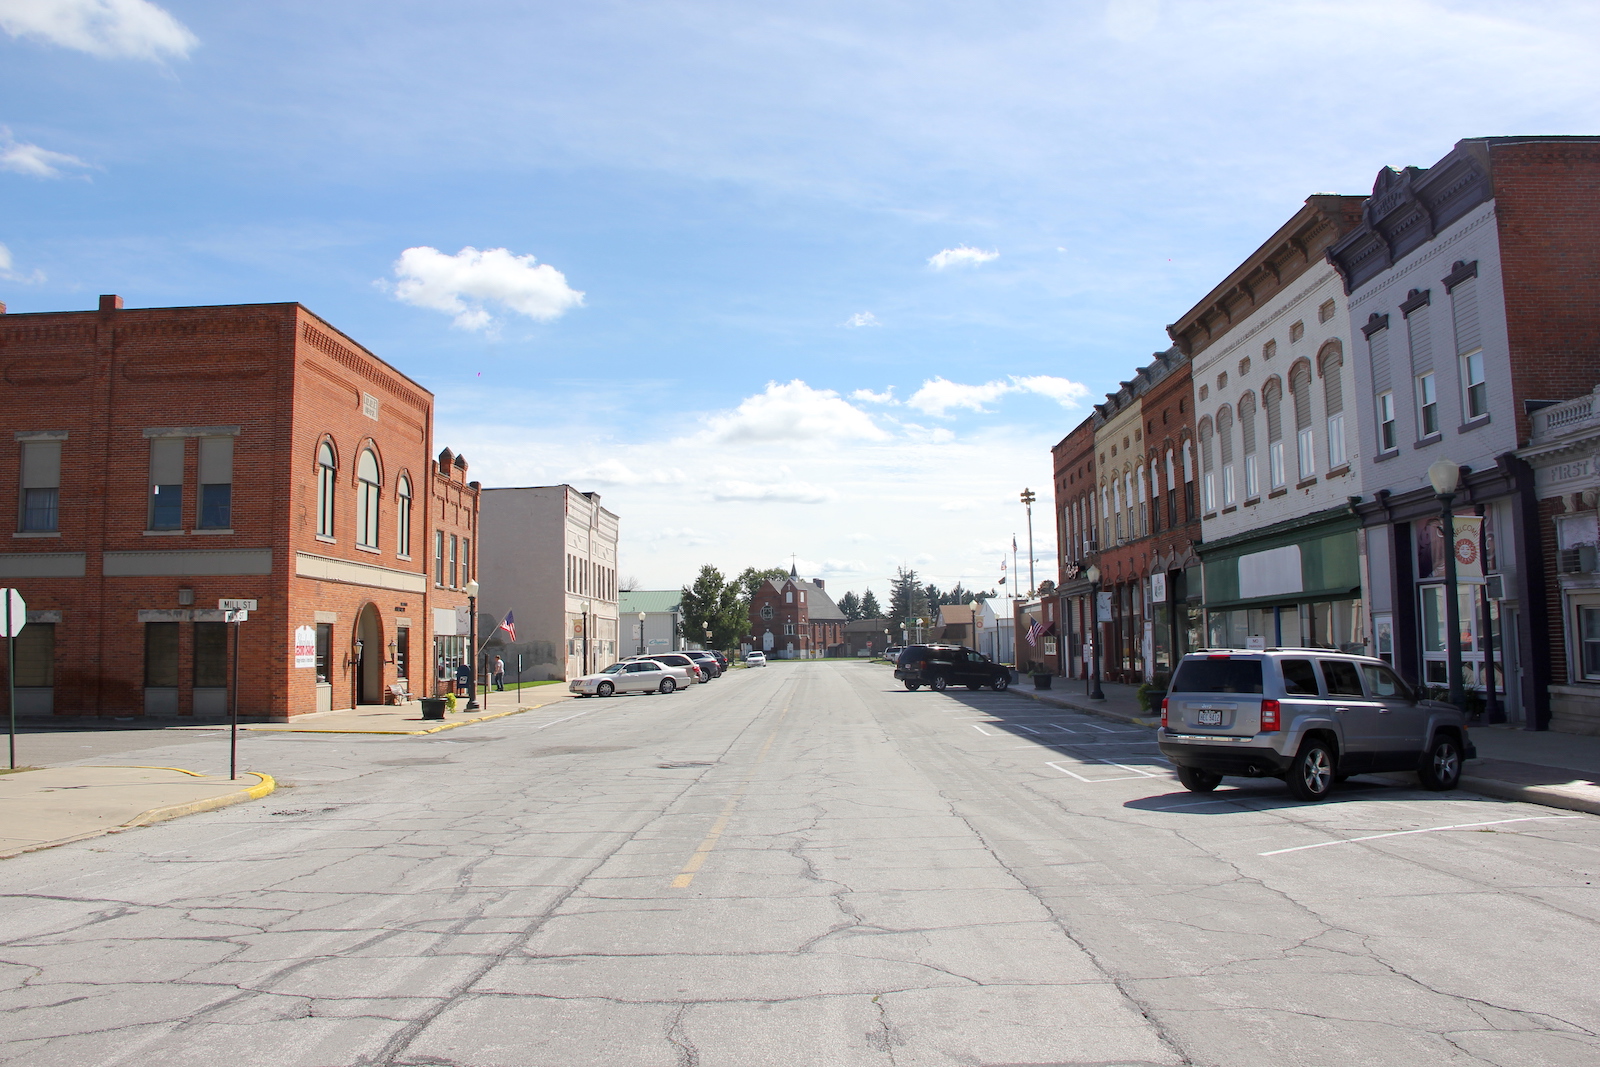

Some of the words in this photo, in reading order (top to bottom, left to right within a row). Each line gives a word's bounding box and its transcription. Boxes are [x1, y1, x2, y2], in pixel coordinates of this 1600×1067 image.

[1551, 460, 1588, 481] FIRST
[1453, 524, 1480, 537] WELCOME
[224, 601, 239, 609] MILL
[242, 601, 251, 609] ST
